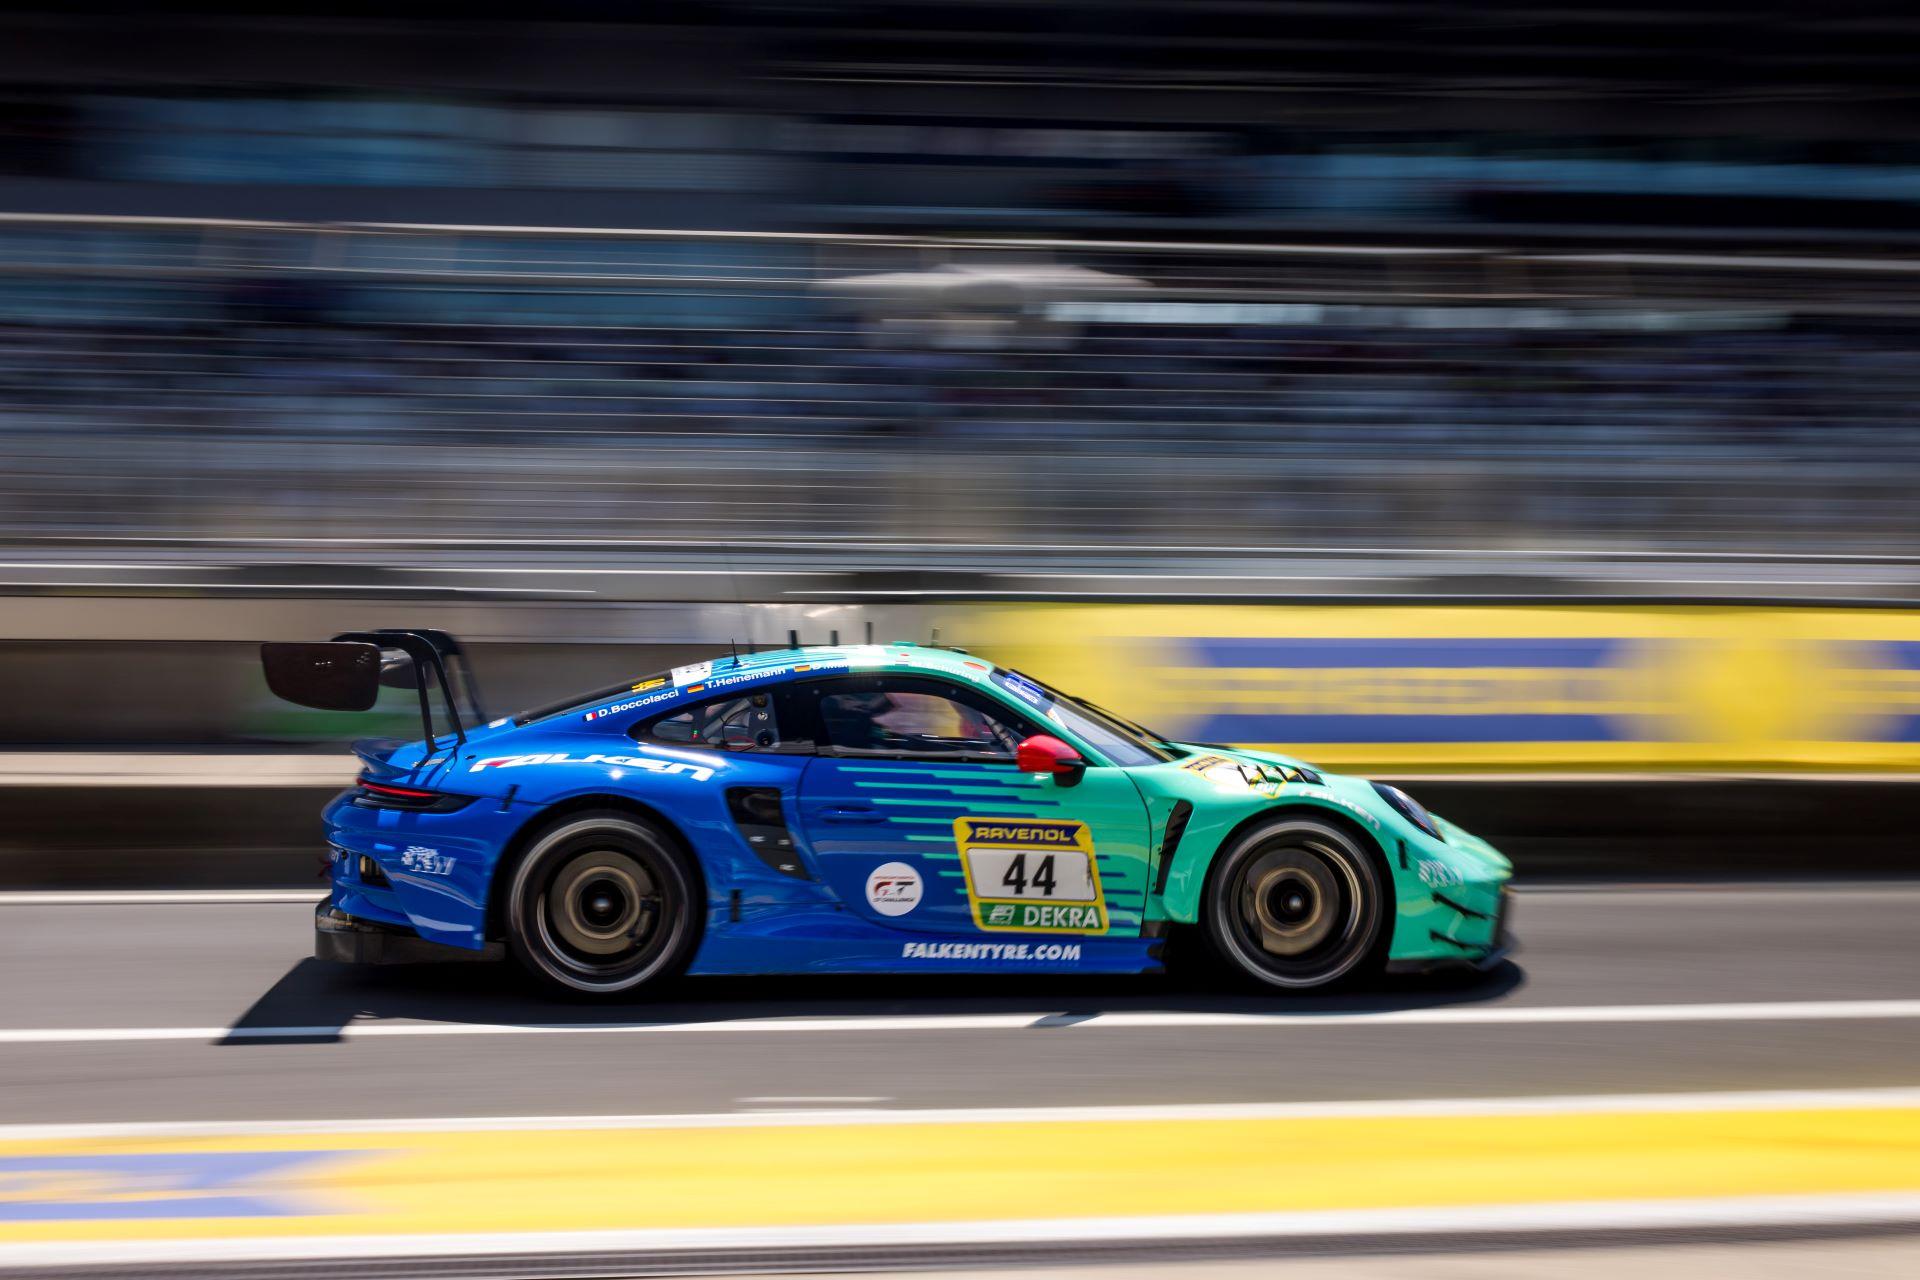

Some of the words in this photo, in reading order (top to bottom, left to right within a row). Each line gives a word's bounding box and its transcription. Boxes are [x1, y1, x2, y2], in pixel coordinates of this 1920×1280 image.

[705, 667, 786, 690] T.Heinemann
[598, 688, 680, 718] D.Boccolacci
[468, 753, 715, 782] FALKEN
[975, 827, 1072, 842] RAVENOL
[1002, 853, 1057, 896] 44
[1023, 906, 1100, 928] DEKRA
[902, 942, 1082, 961] FALKENTYRE.COM
